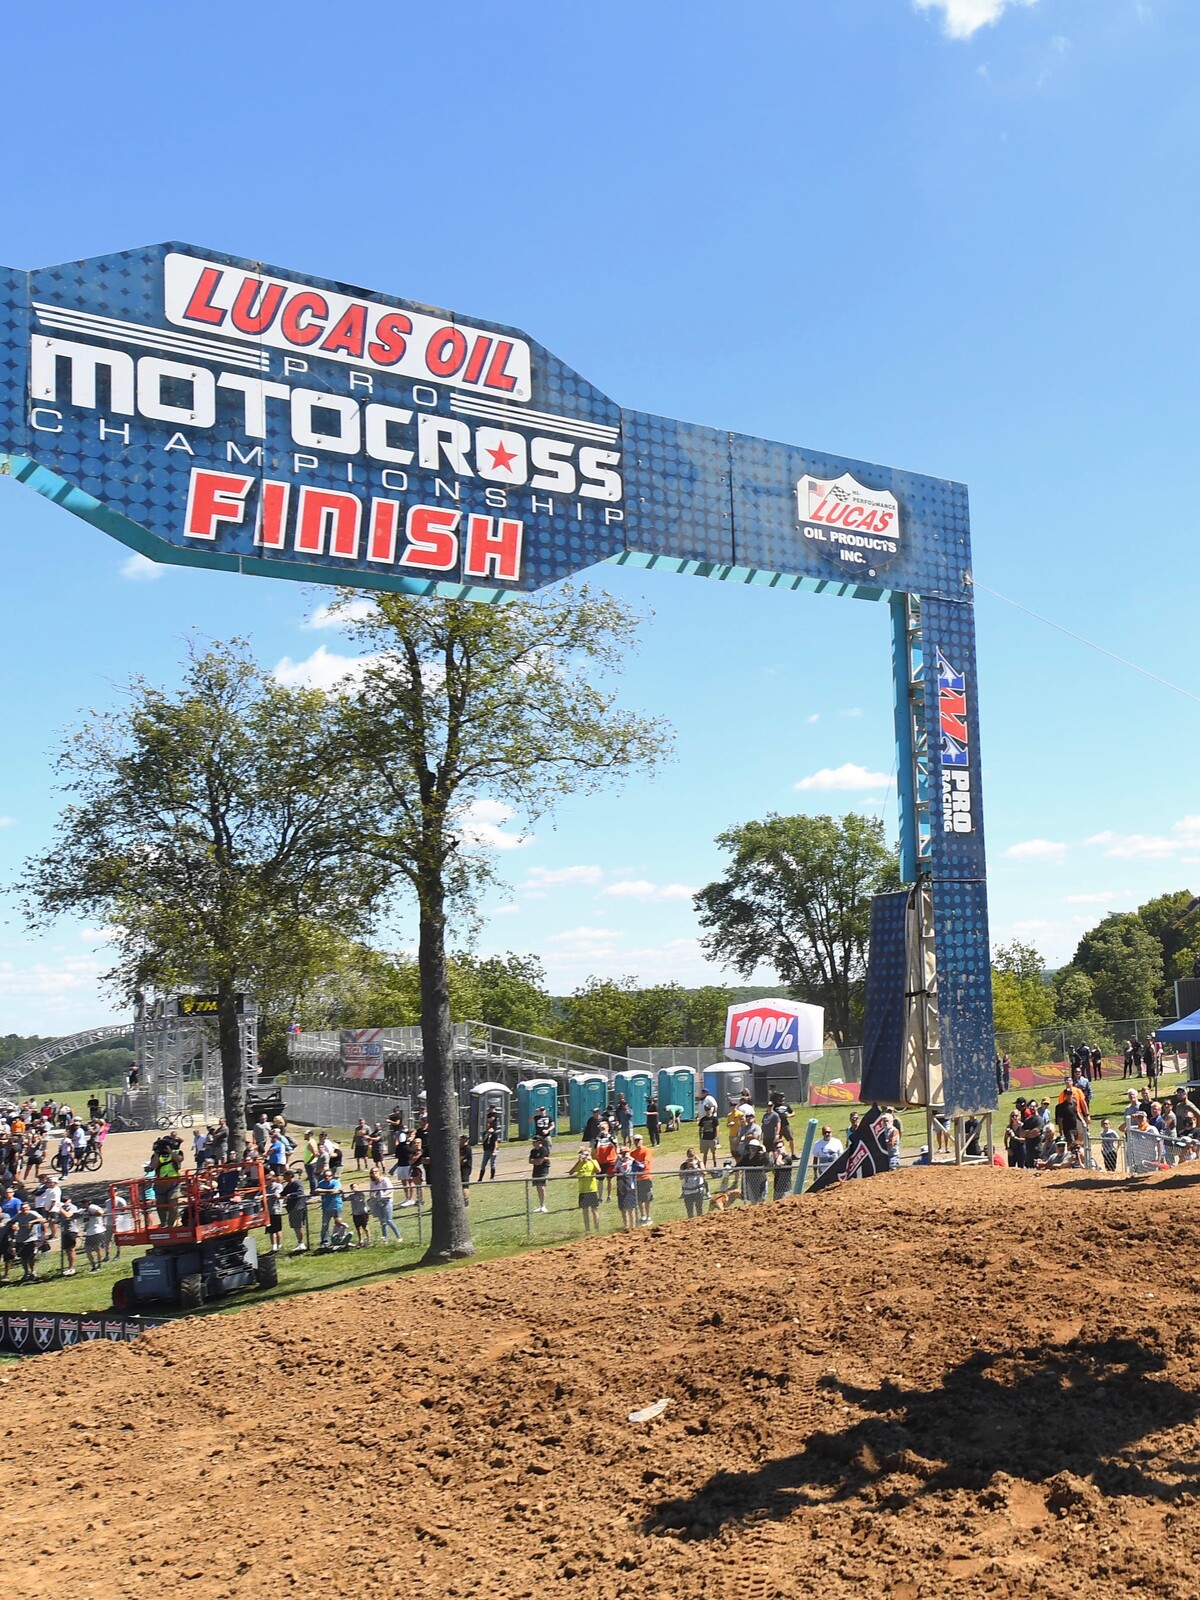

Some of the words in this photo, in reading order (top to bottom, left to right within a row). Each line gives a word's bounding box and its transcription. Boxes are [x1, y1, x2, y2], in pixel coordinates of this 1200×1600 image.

[182, 266, 413, 367] LUCAS
[425, 326, 518, 393] OIL
[284, 356, 439, 408] PRO
[31, 333, 622, 502] MOTOCROSS
[31, 407, 624, 526] CHAMPIONSHIP
[183, 467, 524, 582] FINISH
[803, 526, 827, 541] OIL
[830, 531, 897, 553] PRODUCTS
[809, 499, 894, 532] LUCAS
[840, 549, 867, 564] INC.
[936, 645, 969, 767] AMA
[941, 769, 953, 833] RACING
[951, 770, 972, 833] PRO
[734, 1016, 795, 1050] 100%
